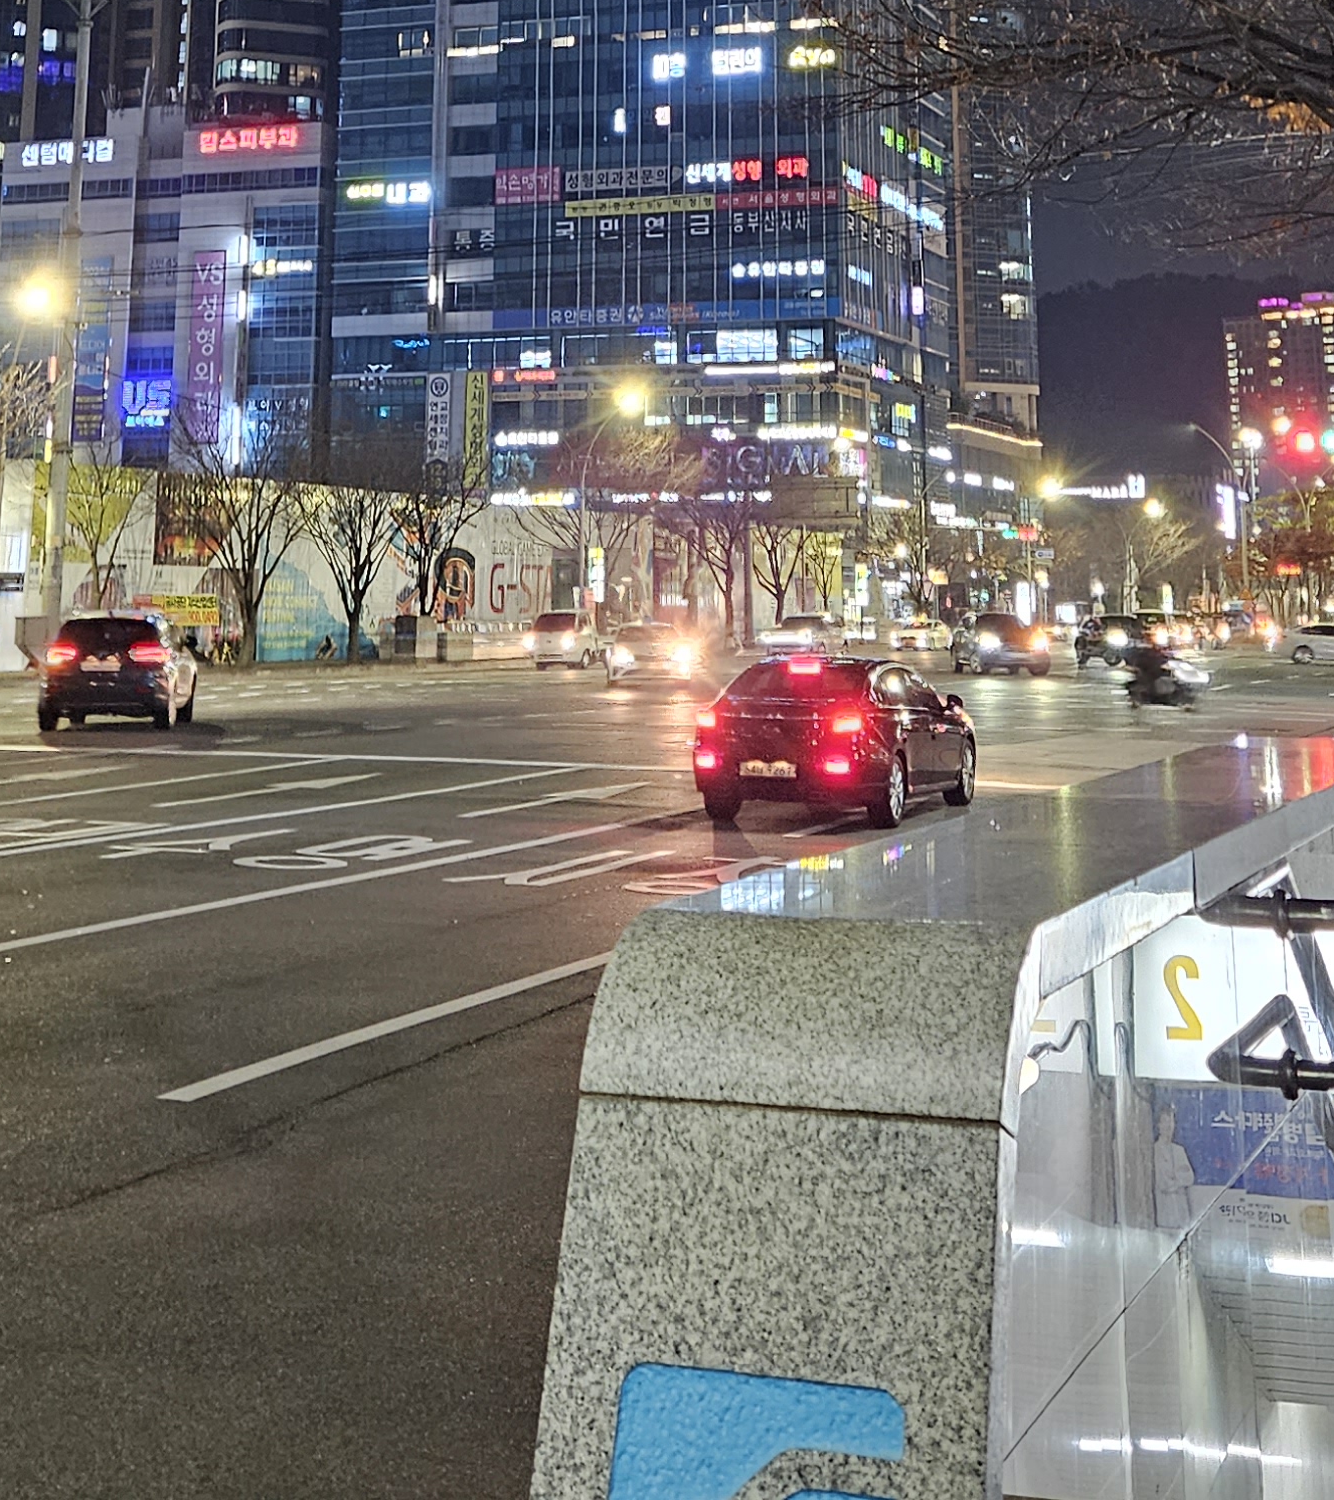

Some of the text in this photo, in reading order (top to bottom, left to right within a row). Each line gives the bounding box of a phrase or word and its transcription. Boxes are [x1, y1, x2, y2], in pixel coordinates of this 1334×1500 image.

[567, 168, 669, 190] 성형외과전문의
[777, 157, 809, 179] 외과
[555, 209, 808, 240] 국민연금 동부산지사
[196, 261, 225, 286] VS
[550, 306, 624, 325] 유안타증권
